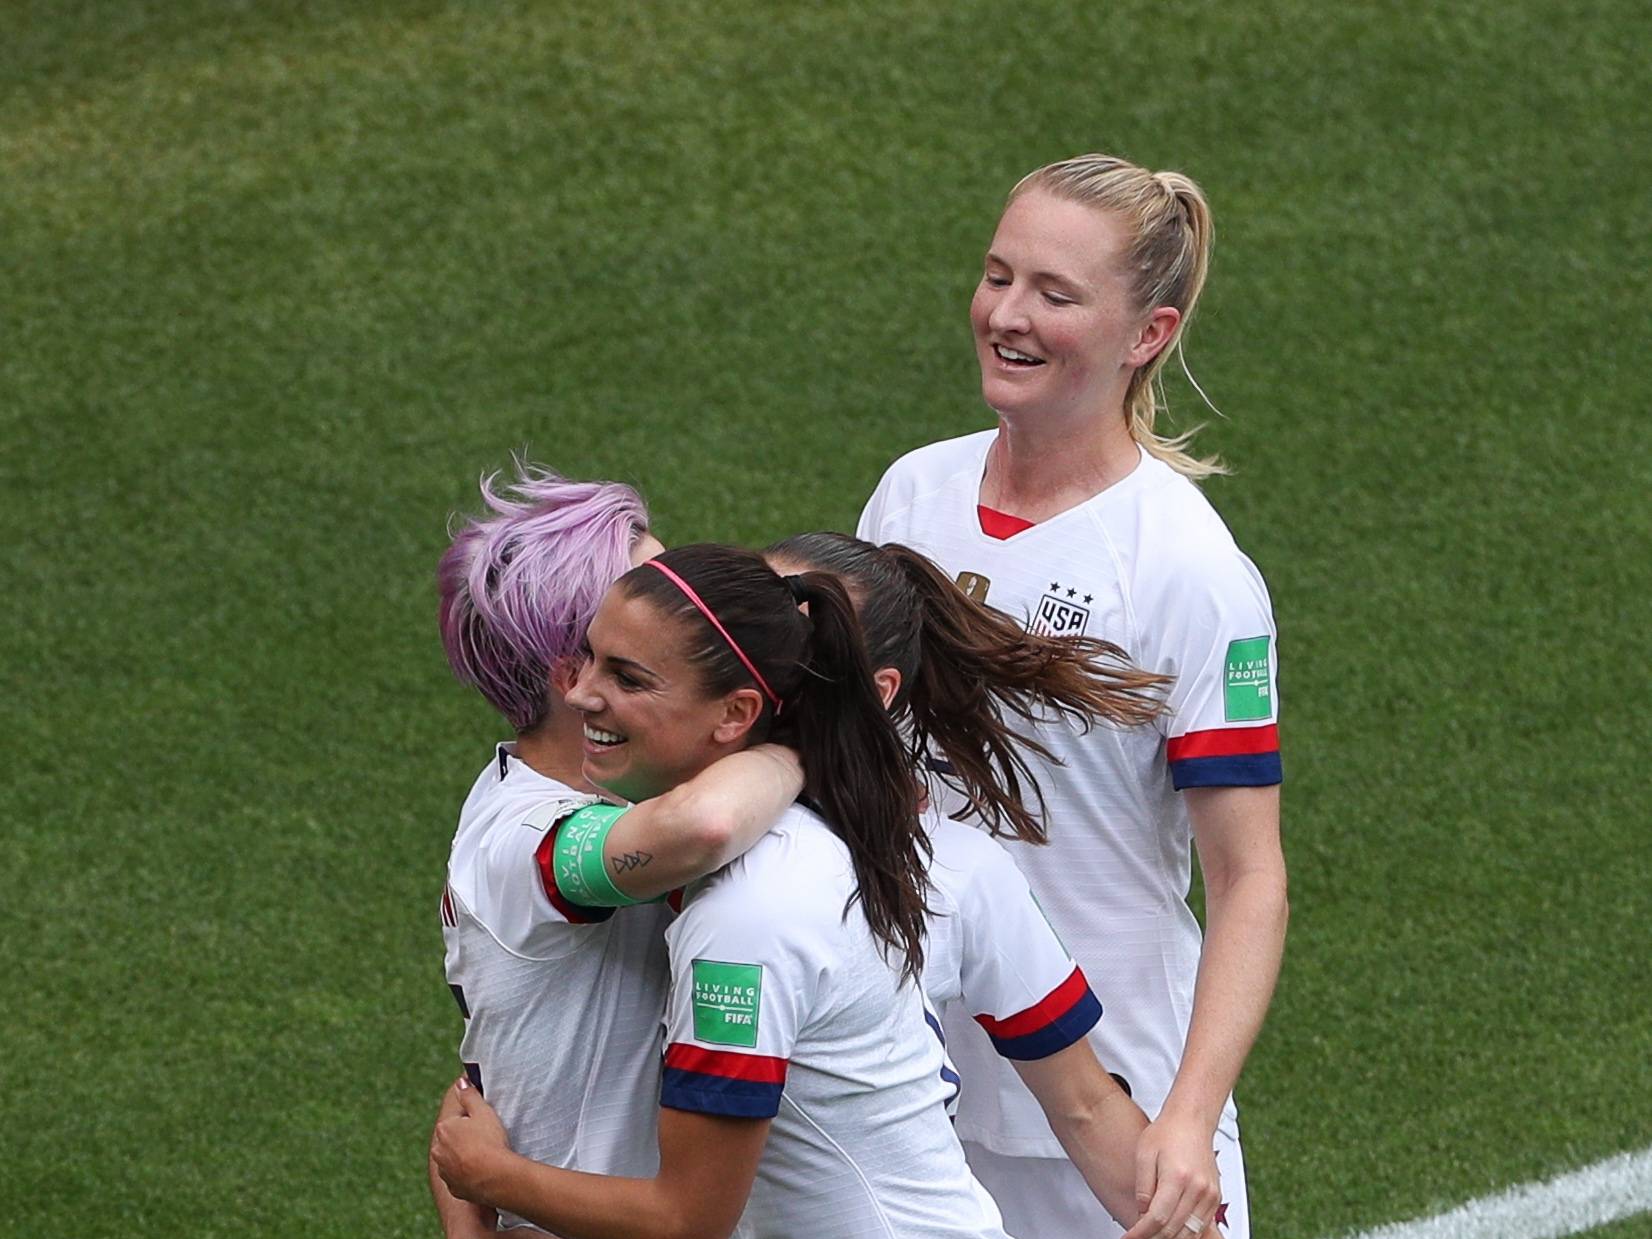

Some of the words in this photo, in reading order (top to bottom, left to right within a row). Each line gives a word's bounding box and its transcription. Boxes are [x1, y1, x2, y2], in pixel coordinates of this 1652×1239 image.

[1042, 601, 1084, 631] USA
[1228, 669, 1268, 680] FOOT
[561, 810, 593, 893] IVING
[696, 982, 755, 996] LIVING
[696, 992, 754, 1005] FOOTBALL
[724, 1012, 752, 1025] FIFA
